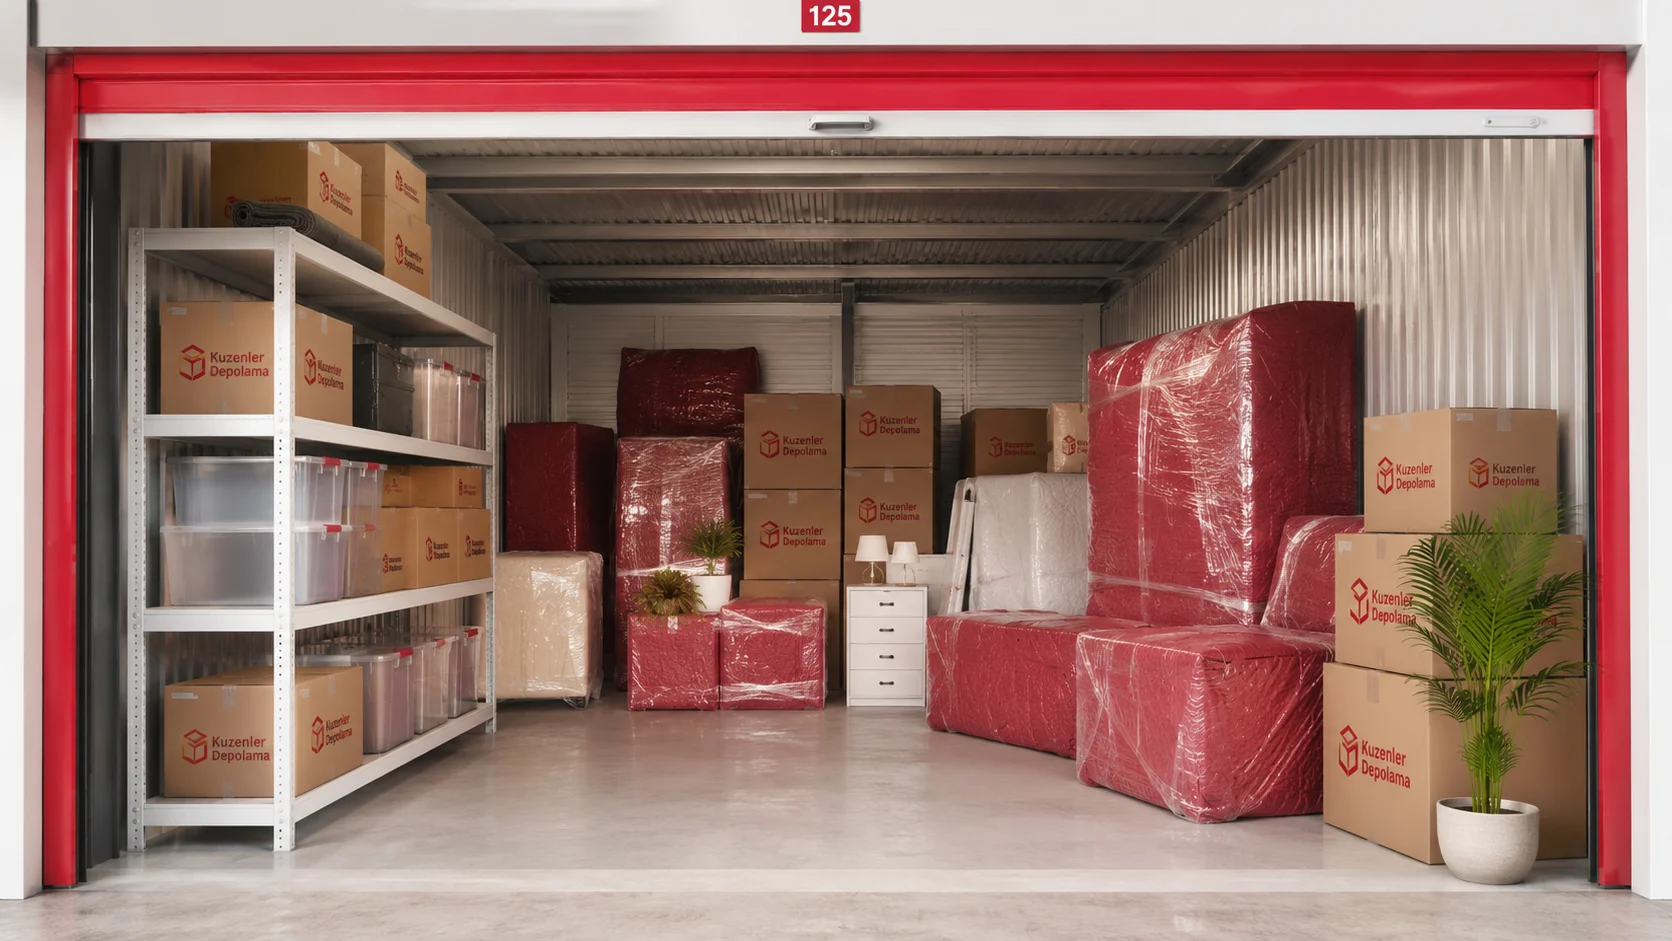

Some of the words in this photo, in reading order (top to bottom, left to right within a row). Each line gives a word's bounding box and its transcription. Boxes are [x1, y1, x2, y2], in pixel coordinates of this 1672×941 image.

[809, 5, 852, 26] 125
[210, 352, 265, 363] Kuzenler
[210, 366, 269, 379] Depolama
[879, 415, 918, 425] Kuzenler
[783, 435, 824, 445] Kuzenler
[783, 446, 827, 457] Depolama
[1396, 462, 1433, 475] Kuzenler
[1492, 463, 1537, 474] Kuzenler
[1396, 477, 1436, 491] Depolama
[1492, 475, 1540, 488] Depolama
[879, 502, 918, 511] Kuzenler
[879, 513, 920, 523] Depolama
[783, 526, 824, 536] Kuzenler
[783, 537, 826, 547] Depolama
[1372, 589, 1413, 606] Kuzenler
[1372, 607, 1416, 625] Depolama
[212, 735, 266, 747] Kuzenler
[212, 750, 270, 763] Depolama
[1361, 739, 1407, 767] Kuzenler
[1361, 758, 1411, 789] Depolama
